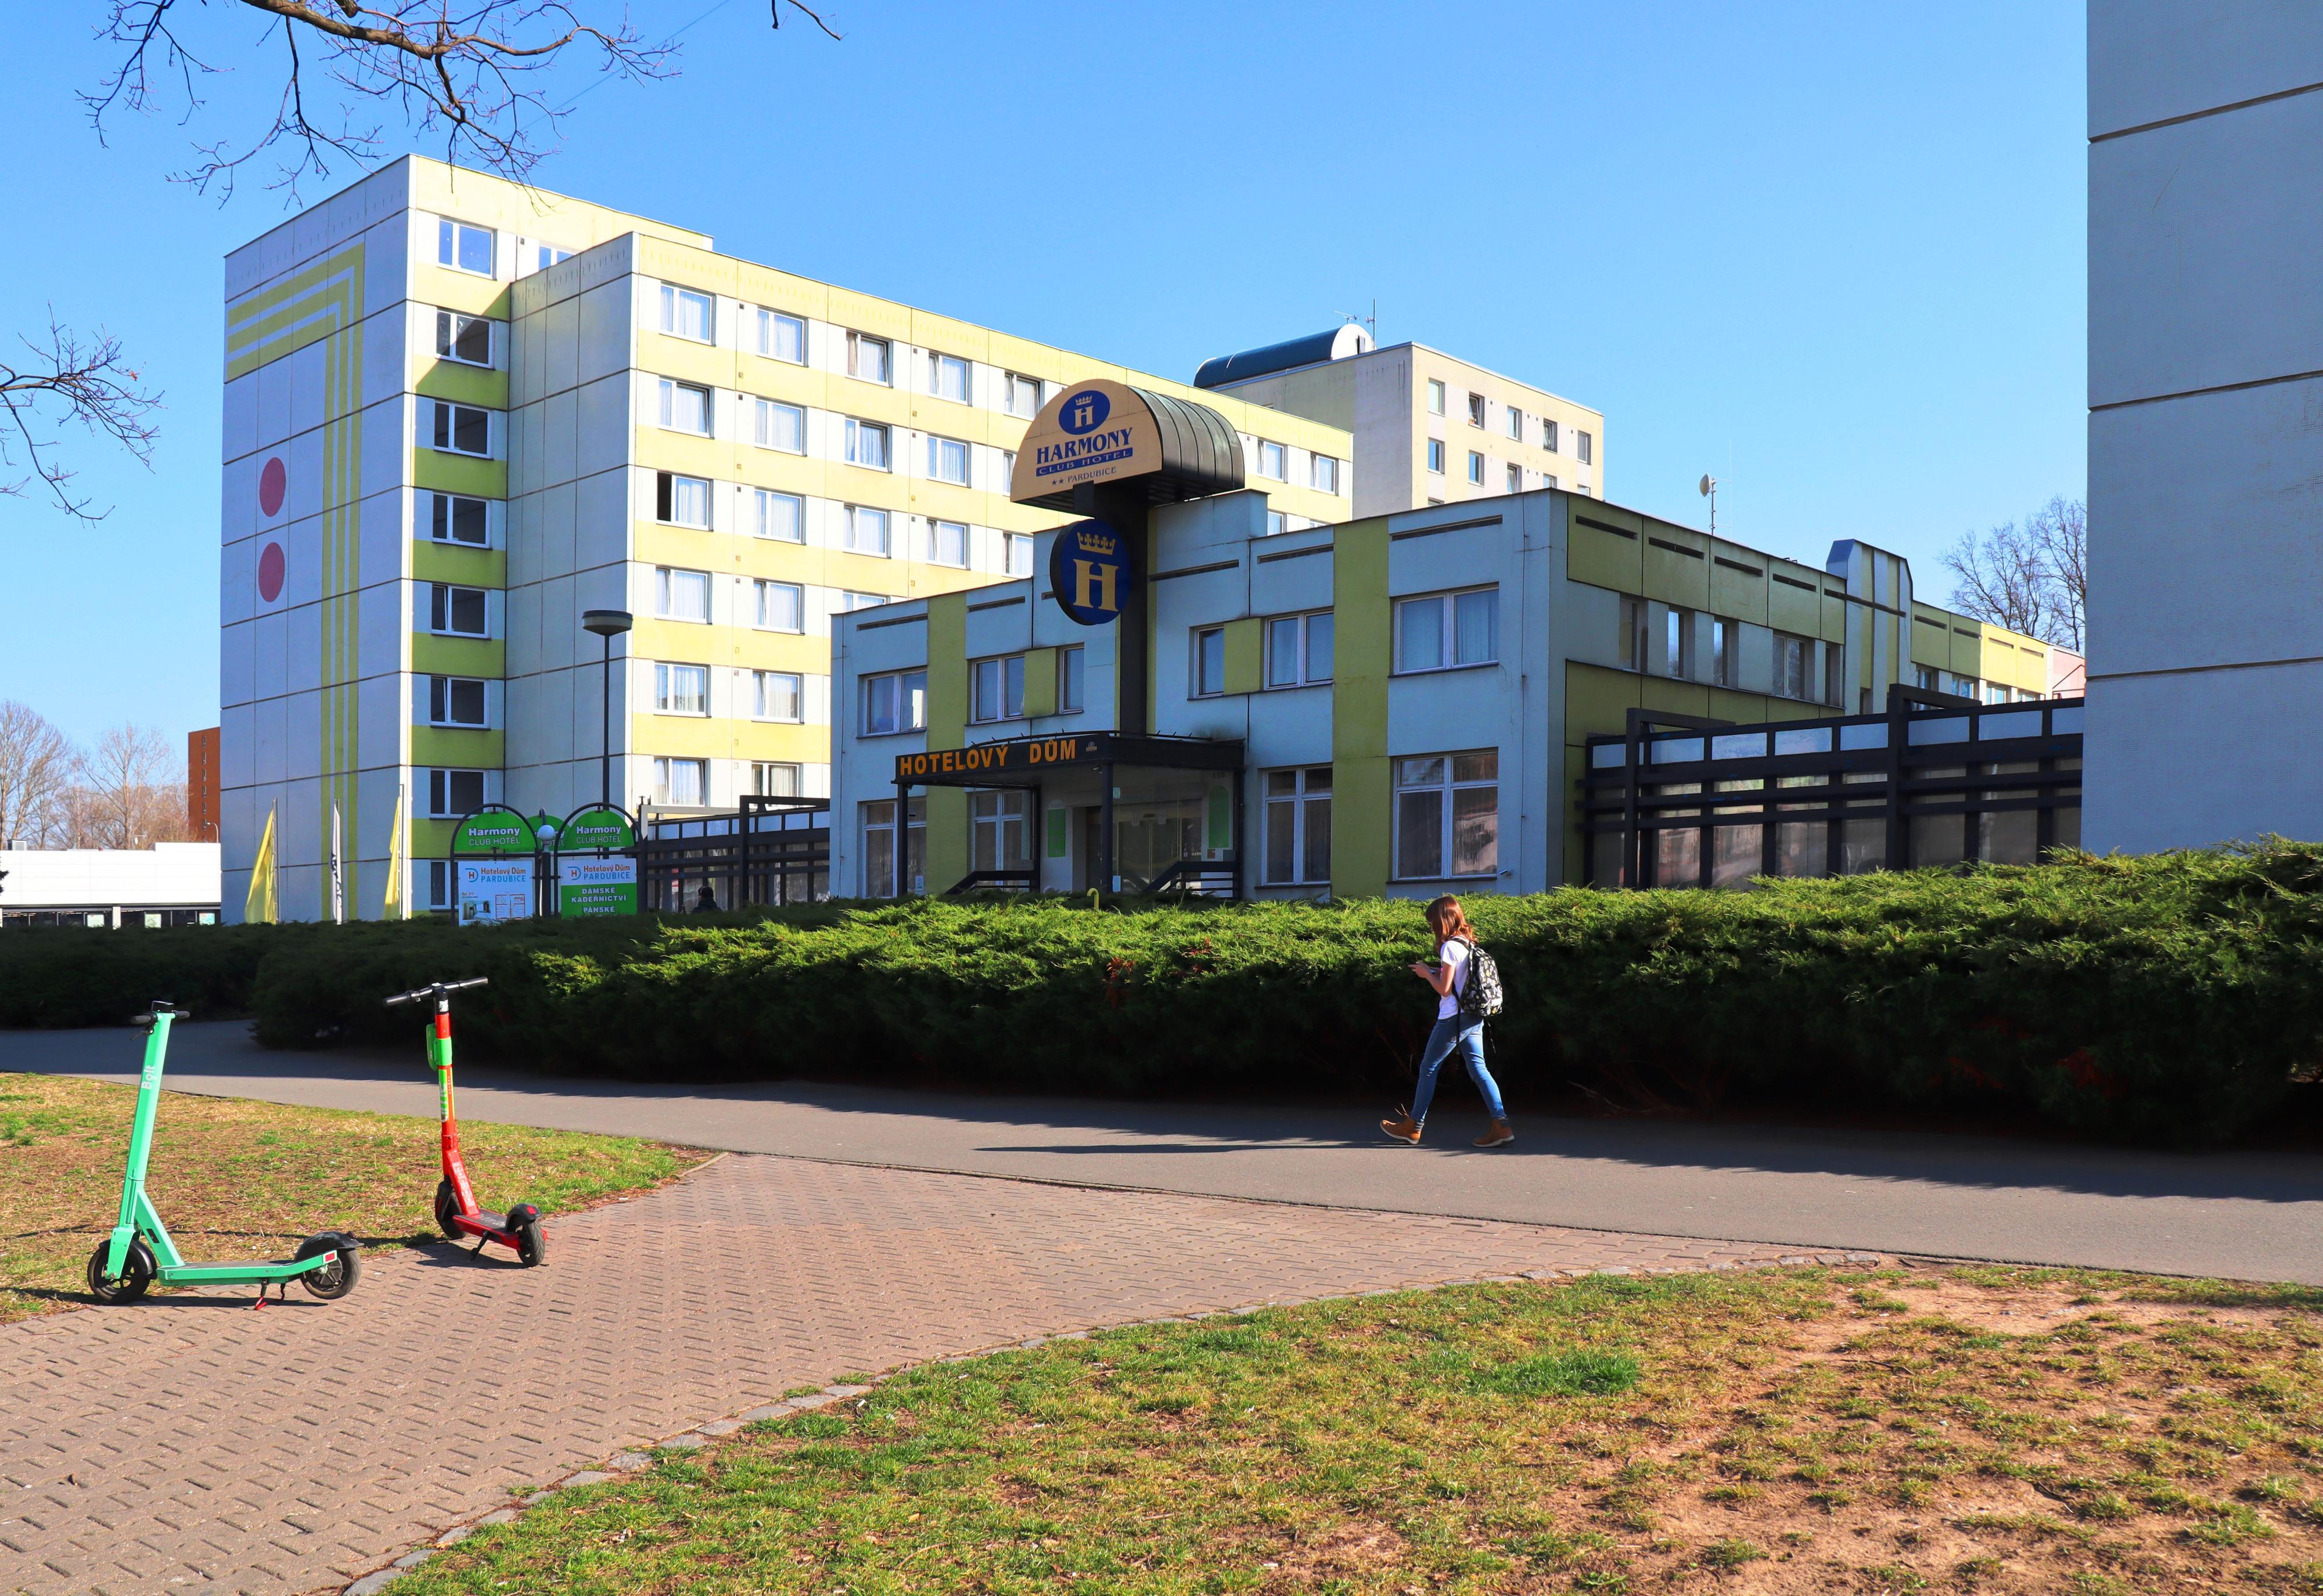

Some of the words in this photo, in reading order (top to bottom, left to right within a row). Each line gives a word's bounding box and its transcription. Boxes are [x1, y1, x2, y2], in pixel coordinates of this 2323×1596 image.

[1074, 405, 1094, 428] H
[1037, 427, 1133, 464] HARMONY
[1039, 462, 1074, 475] CLUB
[1082, 450, 1130, 465] HOTEL
[1067, 466, 1116, 483] PARDUBICE
[1073, 558, 1119, 612] H
[900, 745, 1009, 775] HOTELOVÝ
[1029, 739, 1076, 763] DŮM
[468, 827, 520, 837] Harmony
[576, 825, 622, 836] Harmony
[598, 835, 621, 843] HOTEL
[493, 837, 520, 845] HOTEL
[584, 872, 630, 880] PARDUBICE
[582, 886, 616, 894] DÁMSKÉ
[141, 1065, 156, 1090] Bolt
